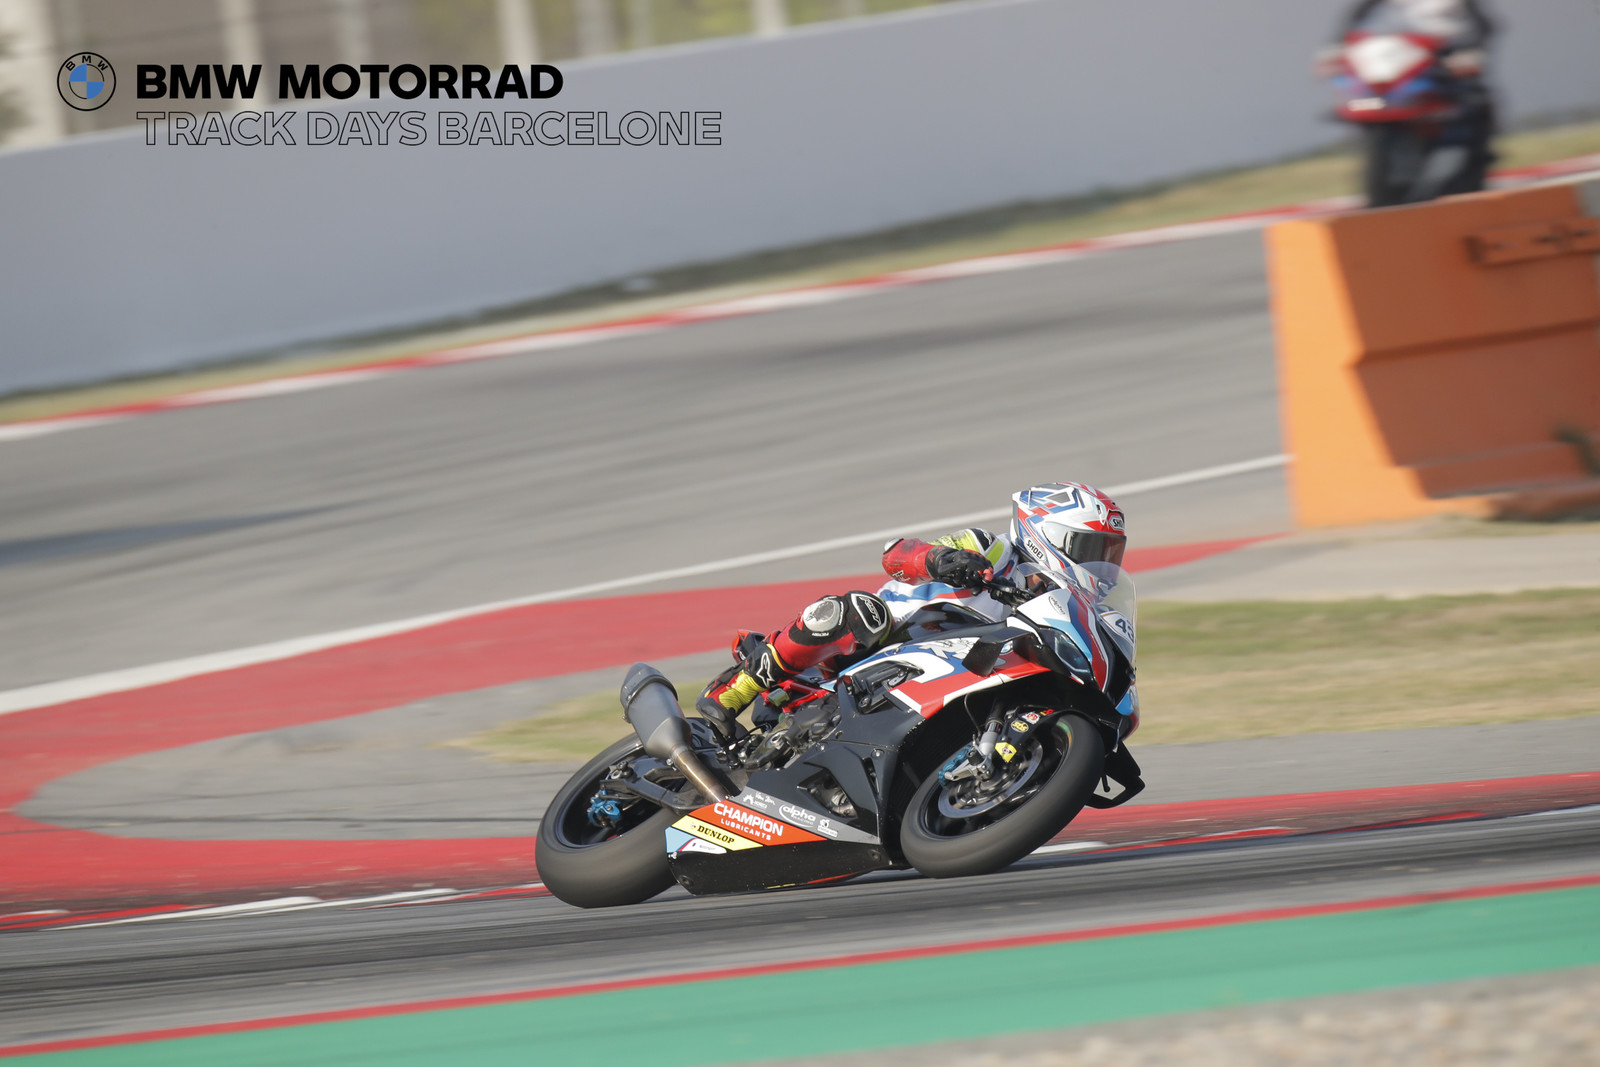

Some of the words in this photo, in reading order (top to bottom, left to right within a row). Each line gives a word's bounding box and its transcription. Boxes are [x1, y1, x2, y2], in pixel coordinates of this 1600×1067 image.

[1026, 539, 1044, 560] SHOEI
[714, 802, 784, 836] CHAMPION
[782, 805, 816, 822] alpha
[697, 825, 735, 844] DUNLOP
[721, 818, 771, 841] LUBRICANTS
